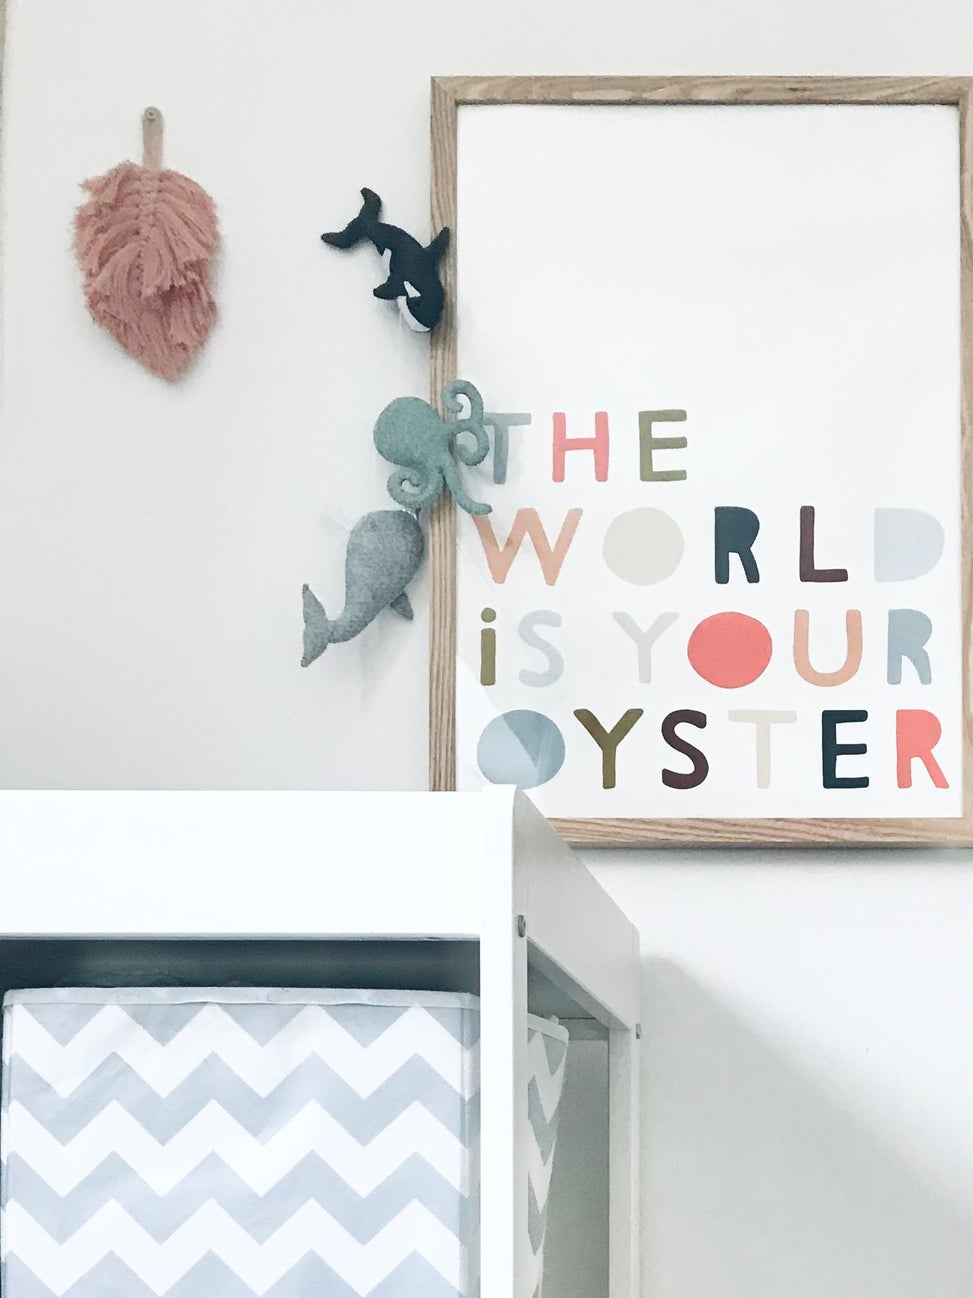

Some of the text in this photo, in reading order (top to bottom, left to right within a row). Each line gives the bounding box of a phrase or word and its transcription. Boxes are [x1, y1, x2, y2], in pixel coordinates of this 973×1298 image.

[484, 409, 688, 484] THE
[473, 505, 946, 586] WORLD
[612, 608, 934, 689] YOUR
[476, 708, 950, 789] OYSTER
